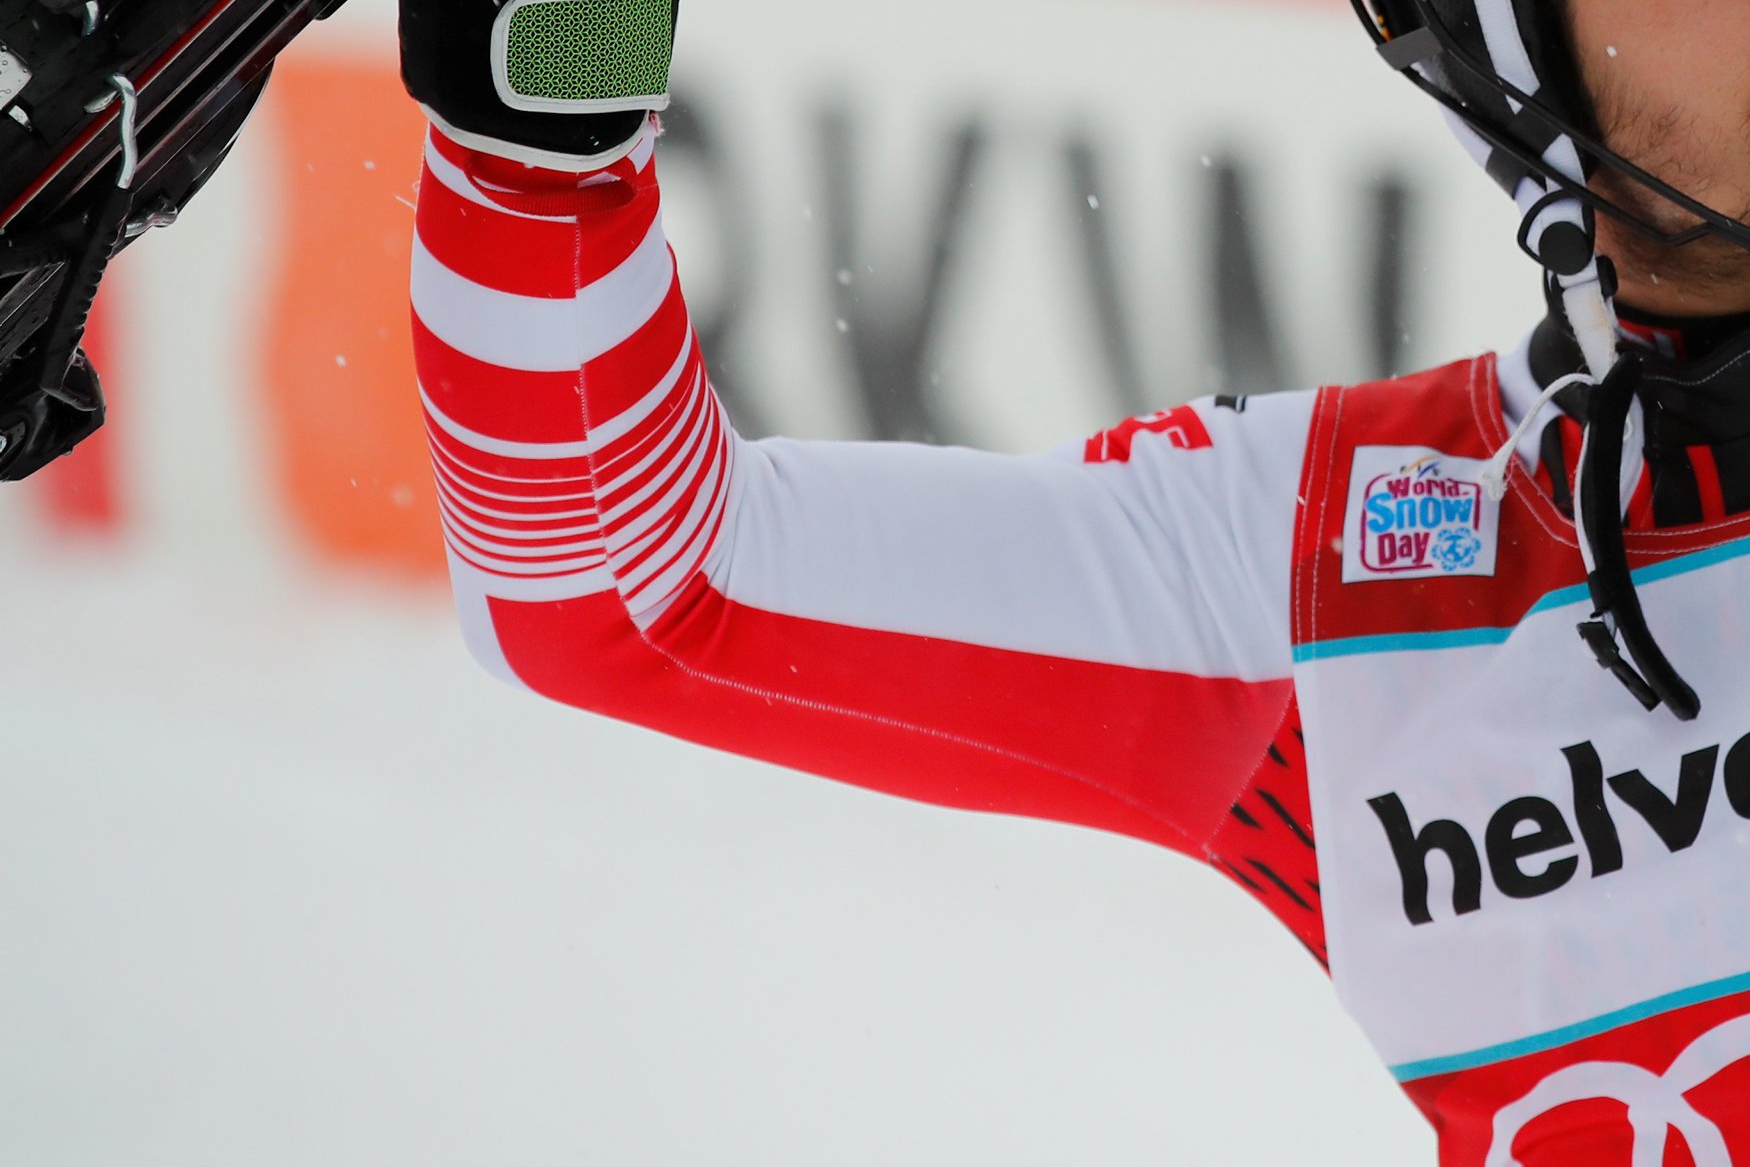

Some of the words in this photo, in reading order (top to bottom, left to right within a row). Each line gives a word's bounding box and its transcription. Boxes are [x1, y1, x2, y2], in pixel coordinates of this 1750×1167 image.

[1387, 476, 1461, 499] World
[1366, 492, 1474, 533] Snow
[1377, 532, 1431, 566] Day
